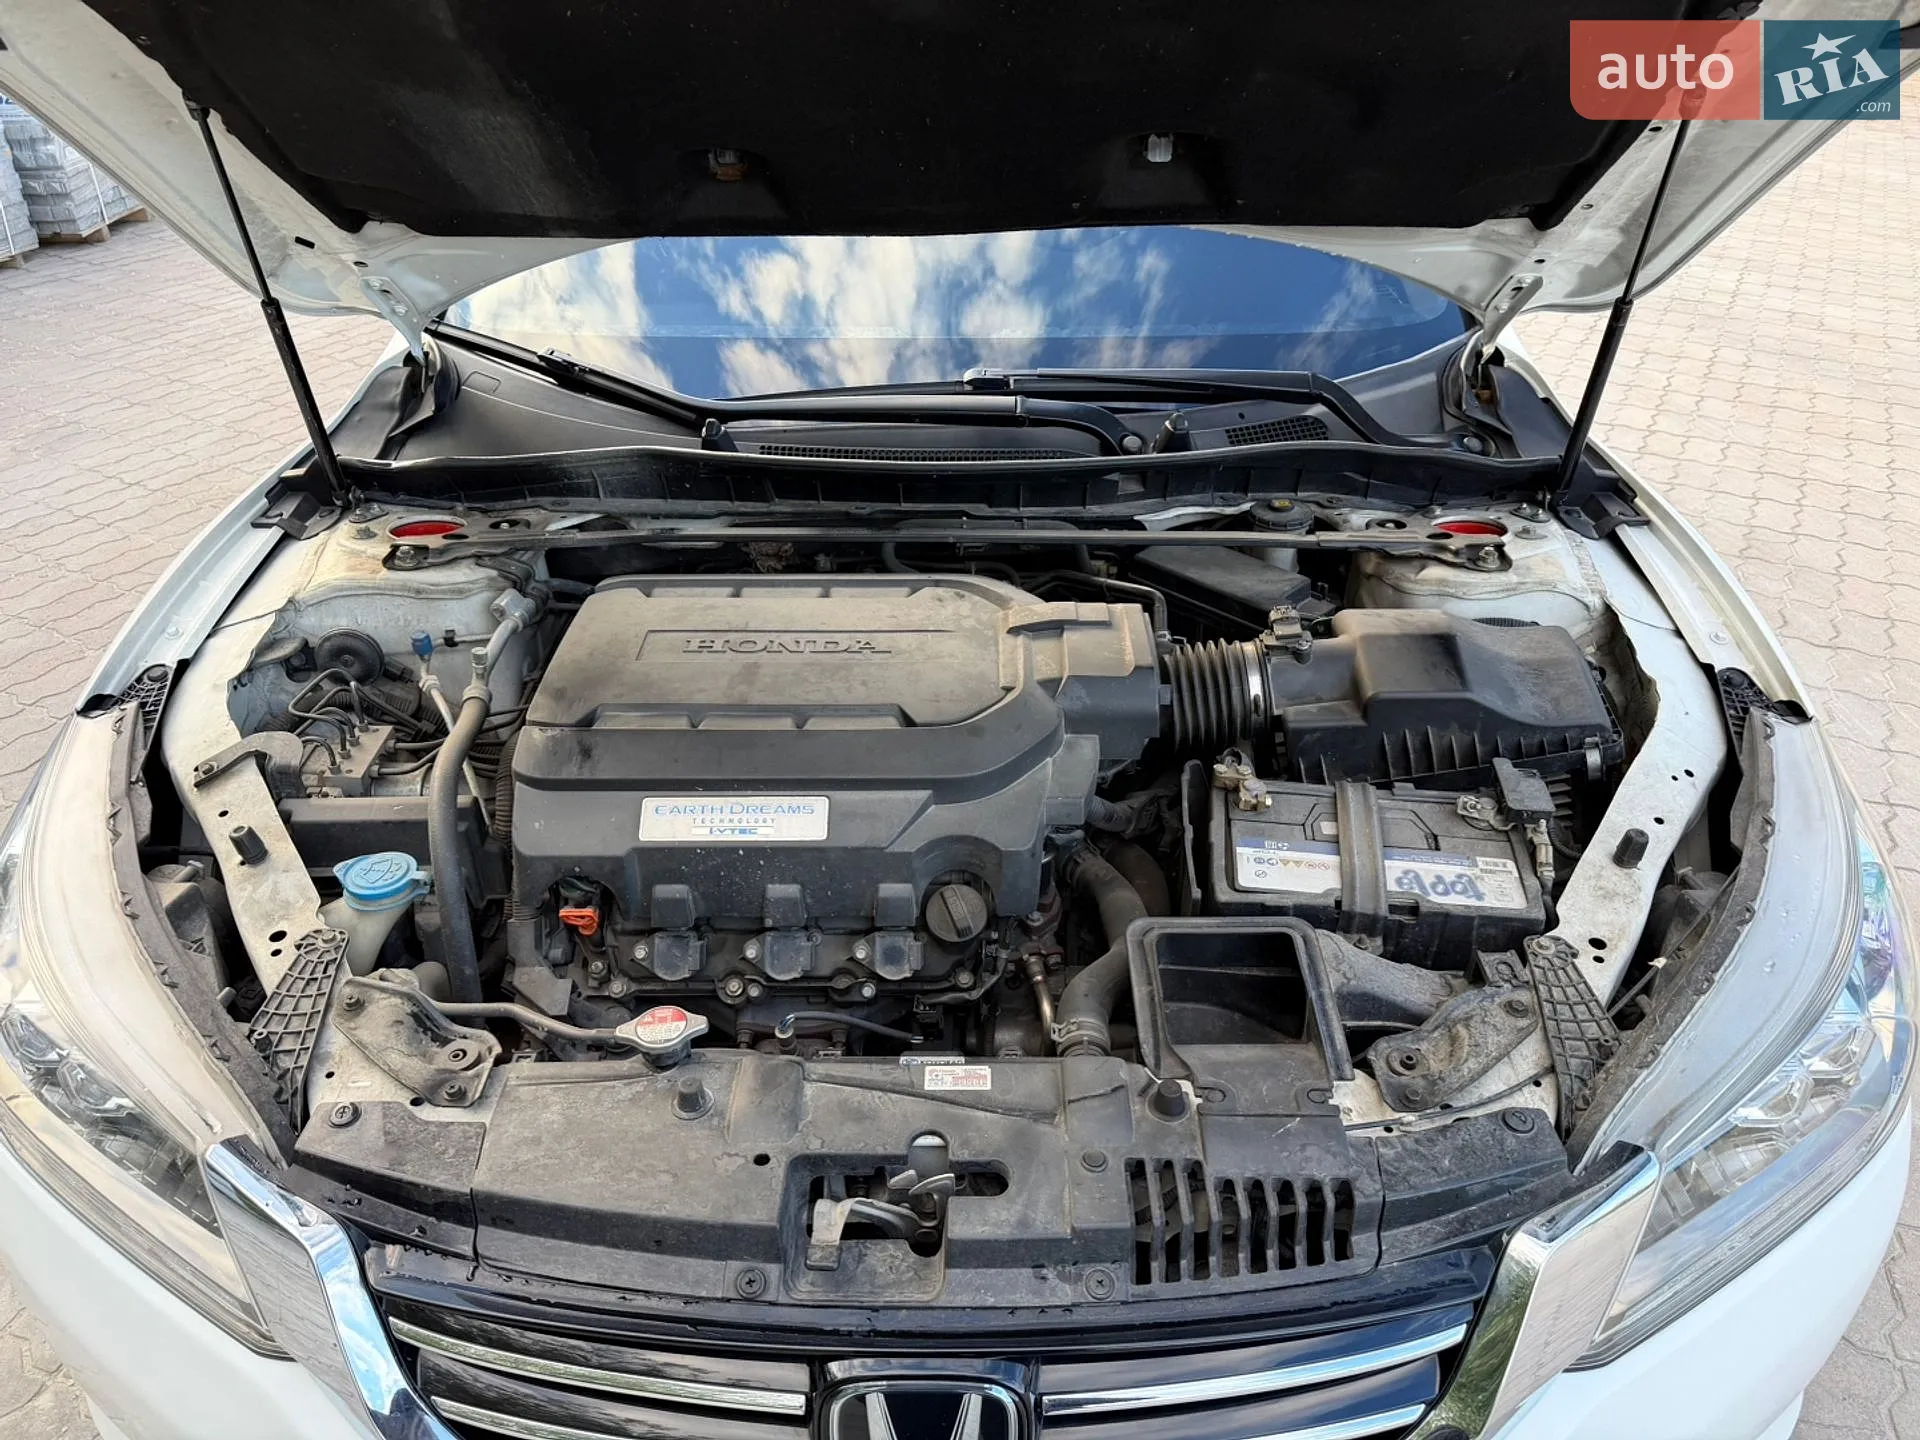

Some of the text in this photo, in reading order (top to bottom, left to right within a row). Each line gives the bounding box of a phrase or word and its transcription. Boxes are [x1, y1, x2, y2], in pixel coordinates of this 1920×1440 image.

[682, 639, 892, 654] HONDA
[654, 803, 815, 815] EARTH DREAMS
[692, 817, 777, 825] TECHNOLOGY
